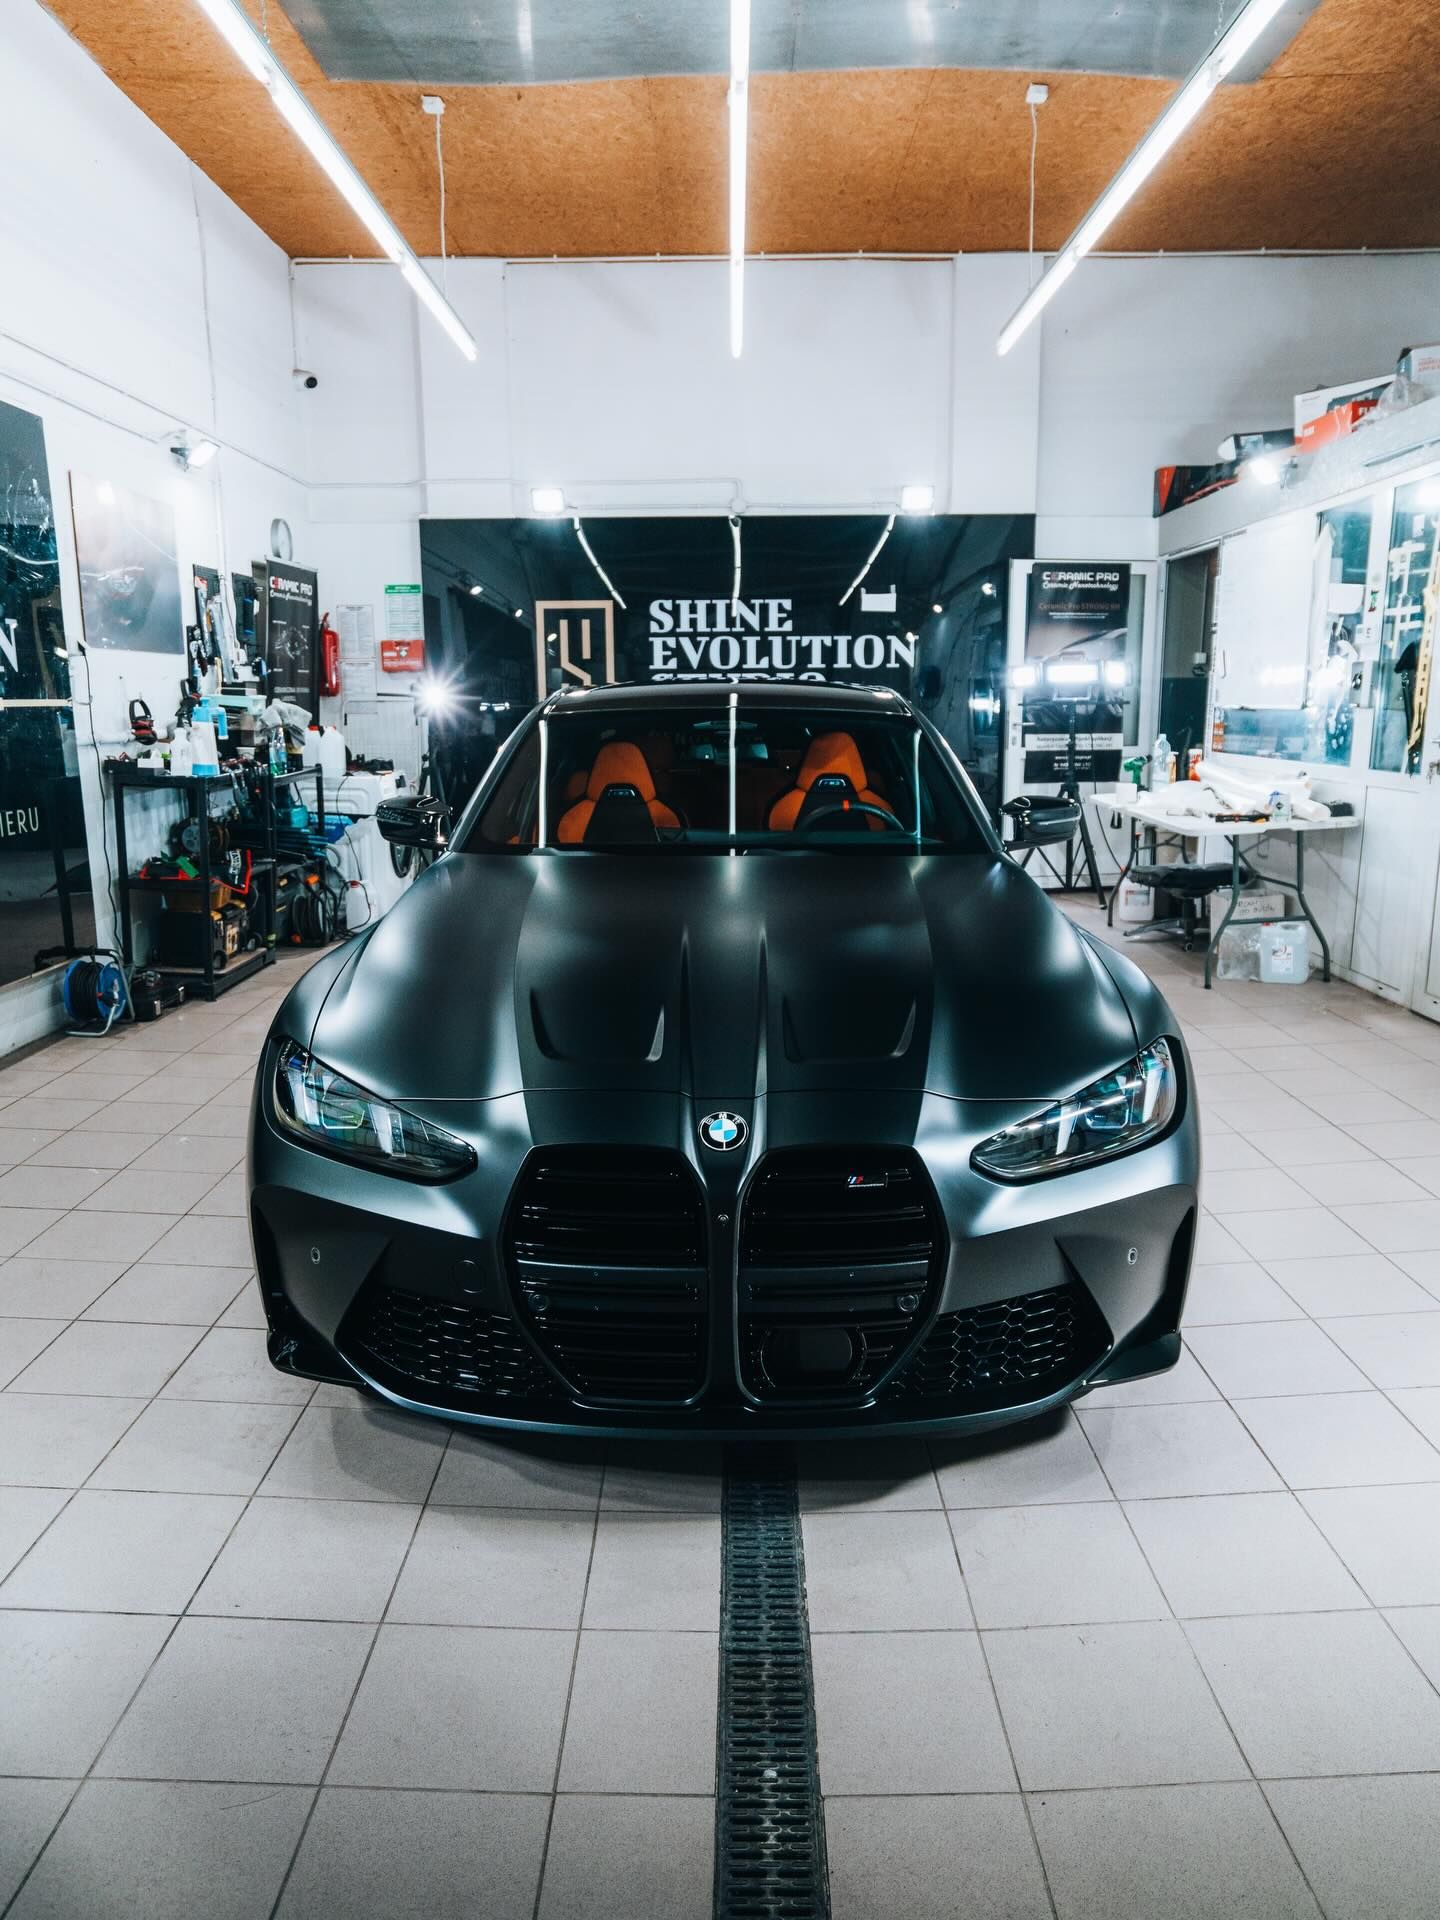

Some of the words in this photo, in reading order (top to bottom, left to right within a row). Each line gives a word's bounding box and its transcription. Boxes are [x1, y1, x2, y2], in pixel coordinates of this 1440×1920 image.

[1042, 571, 1095, 582] CERAMIC
[1096, 572, 1120, 582] PRO
[649, 599, 793, 633] SHINE
[649, 635, 919, 670] EVOLUTION
